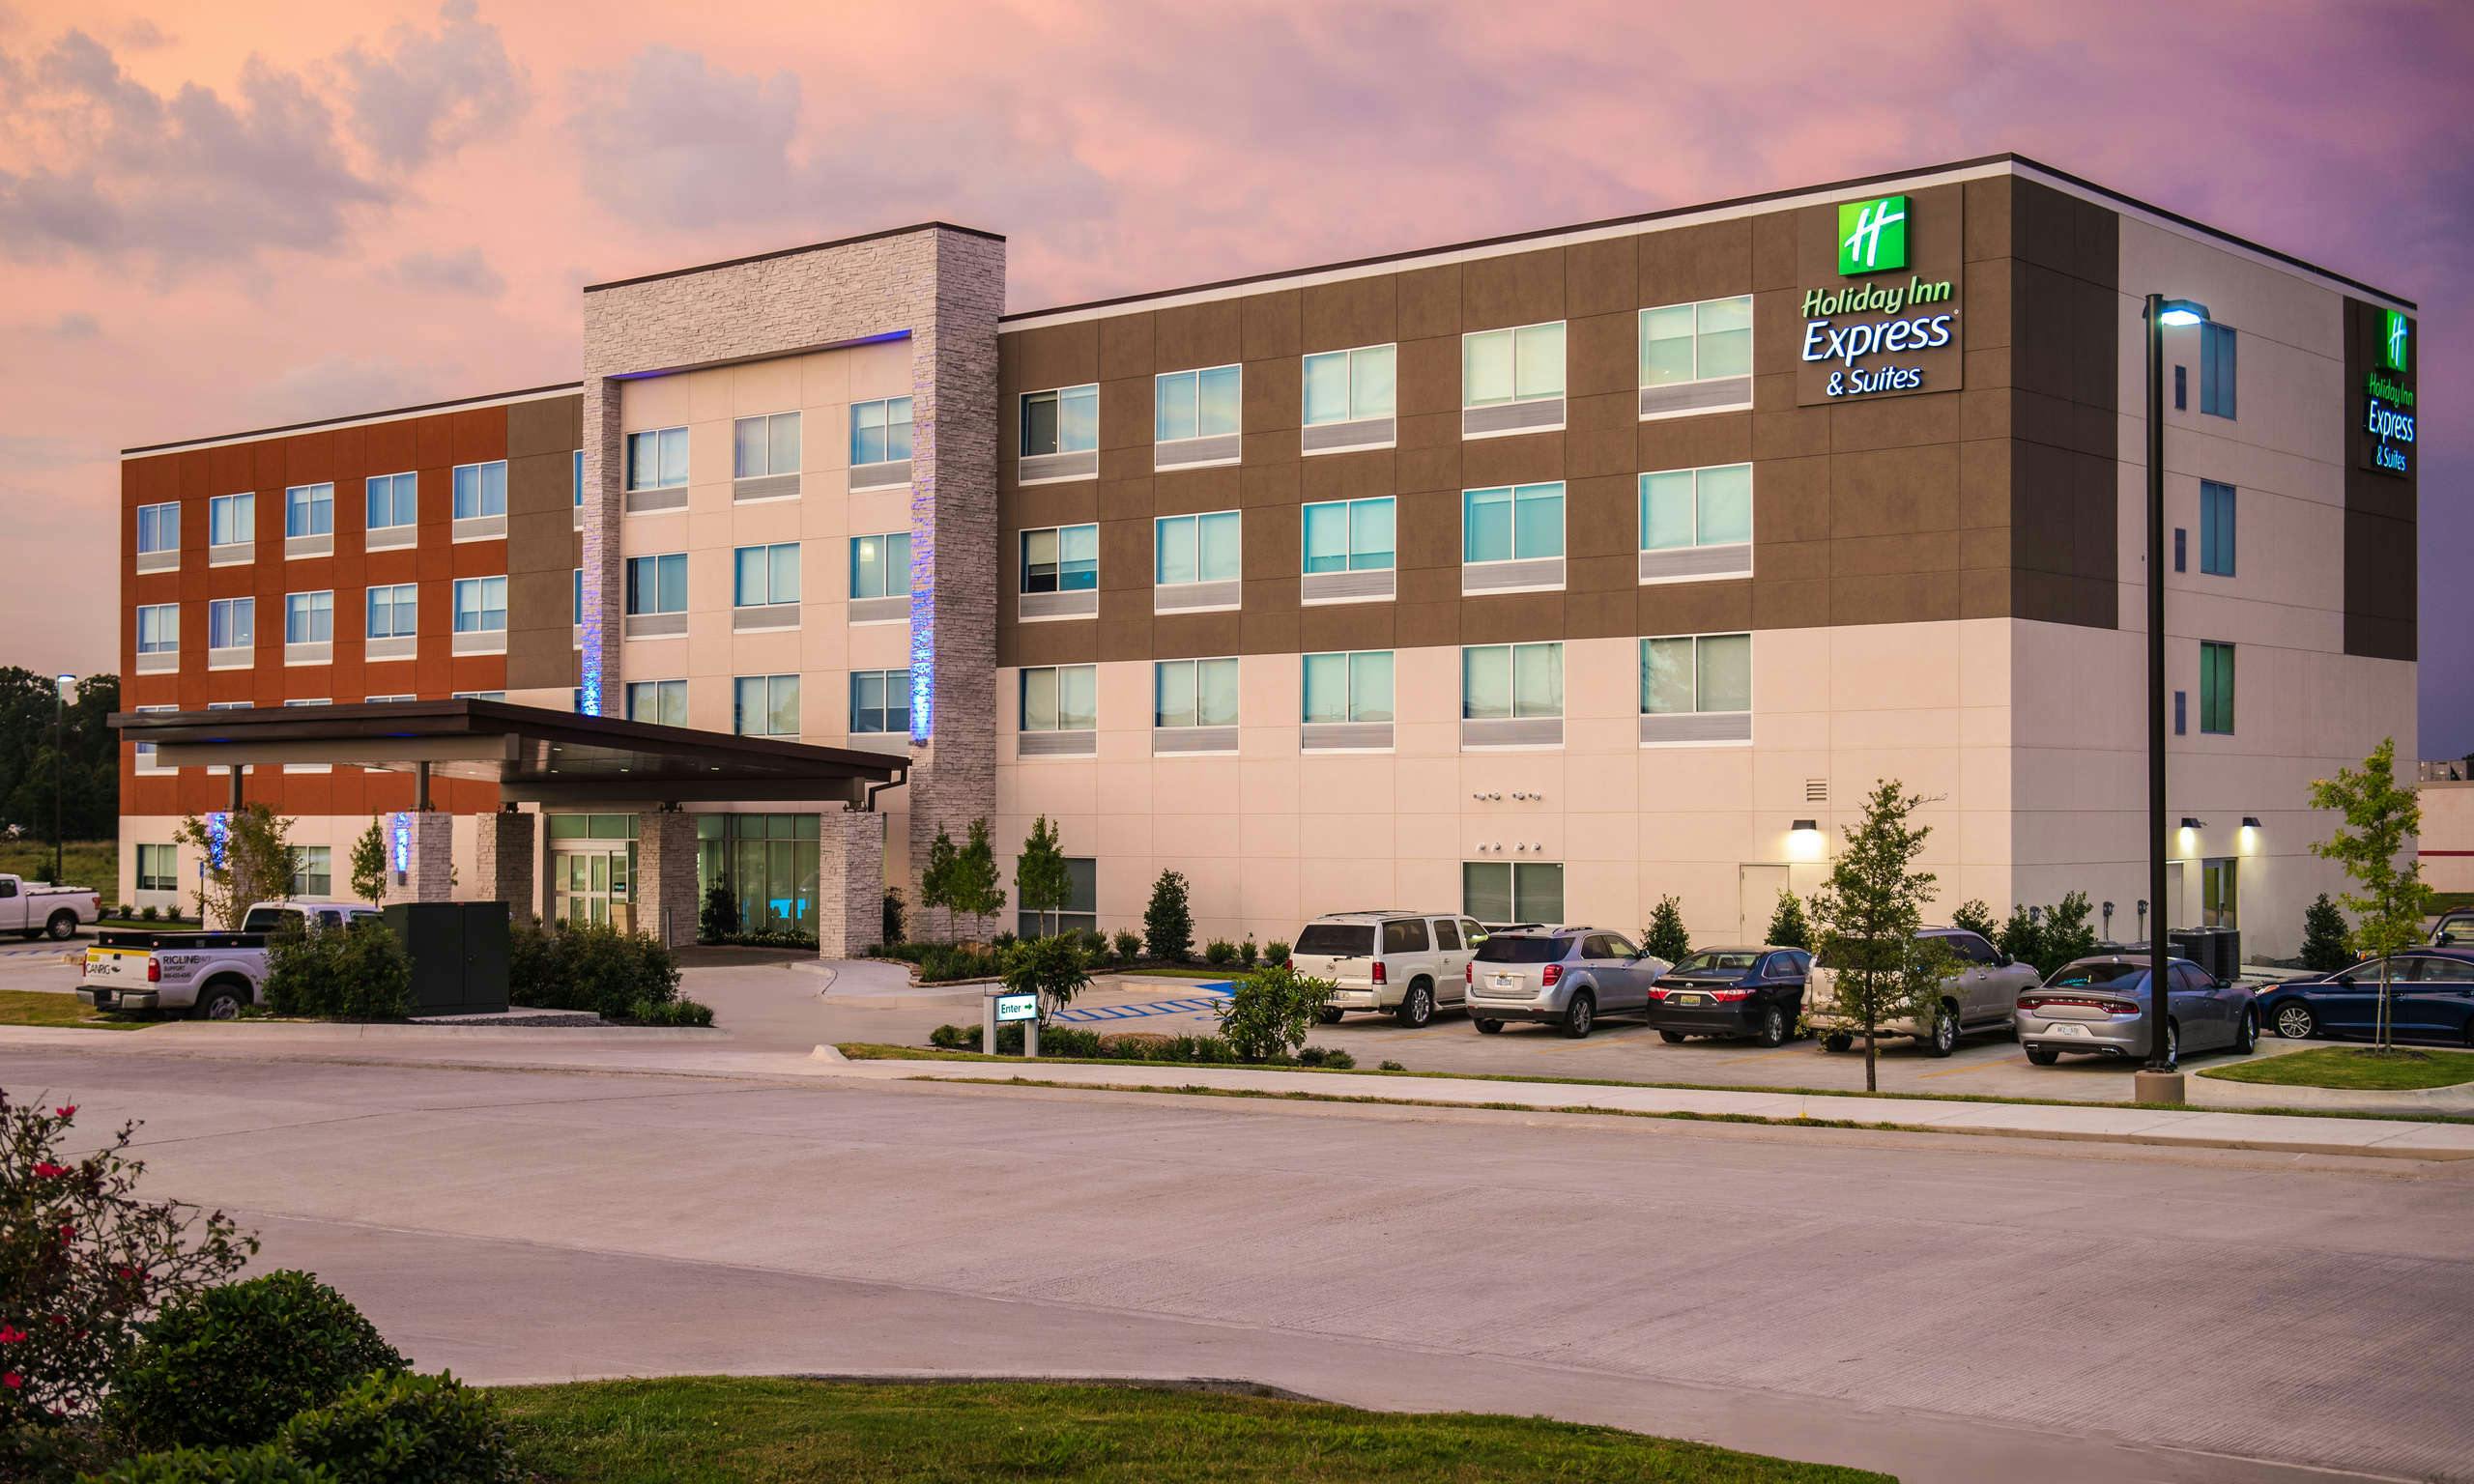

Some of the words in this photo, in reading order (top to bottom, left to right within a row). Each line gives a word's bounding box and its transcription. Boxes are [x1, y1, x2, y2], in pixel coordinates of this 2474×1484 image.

[1801, 282, 1904, 318] Holiday
[1908, 275, 1950, 305] Inn
[1801, 314, 1952, 368] Express
[1826, 371, 1844, 397] &
[1849, 366, 1922, 394] Suites
[2370, 373, 2401, 408] Holiday
[2401, 381, 2413, 407] Inn
[2369, 400, 2414, 444] Express
[2375, 445, 2383, 465] &
[2383, 447, 2406, 471] Suites
[86, 963, 110, 975] CANRIG
[162, 956, 201, 964] RIGLINE
[1001, 1004, 1021, 1013] Enter
